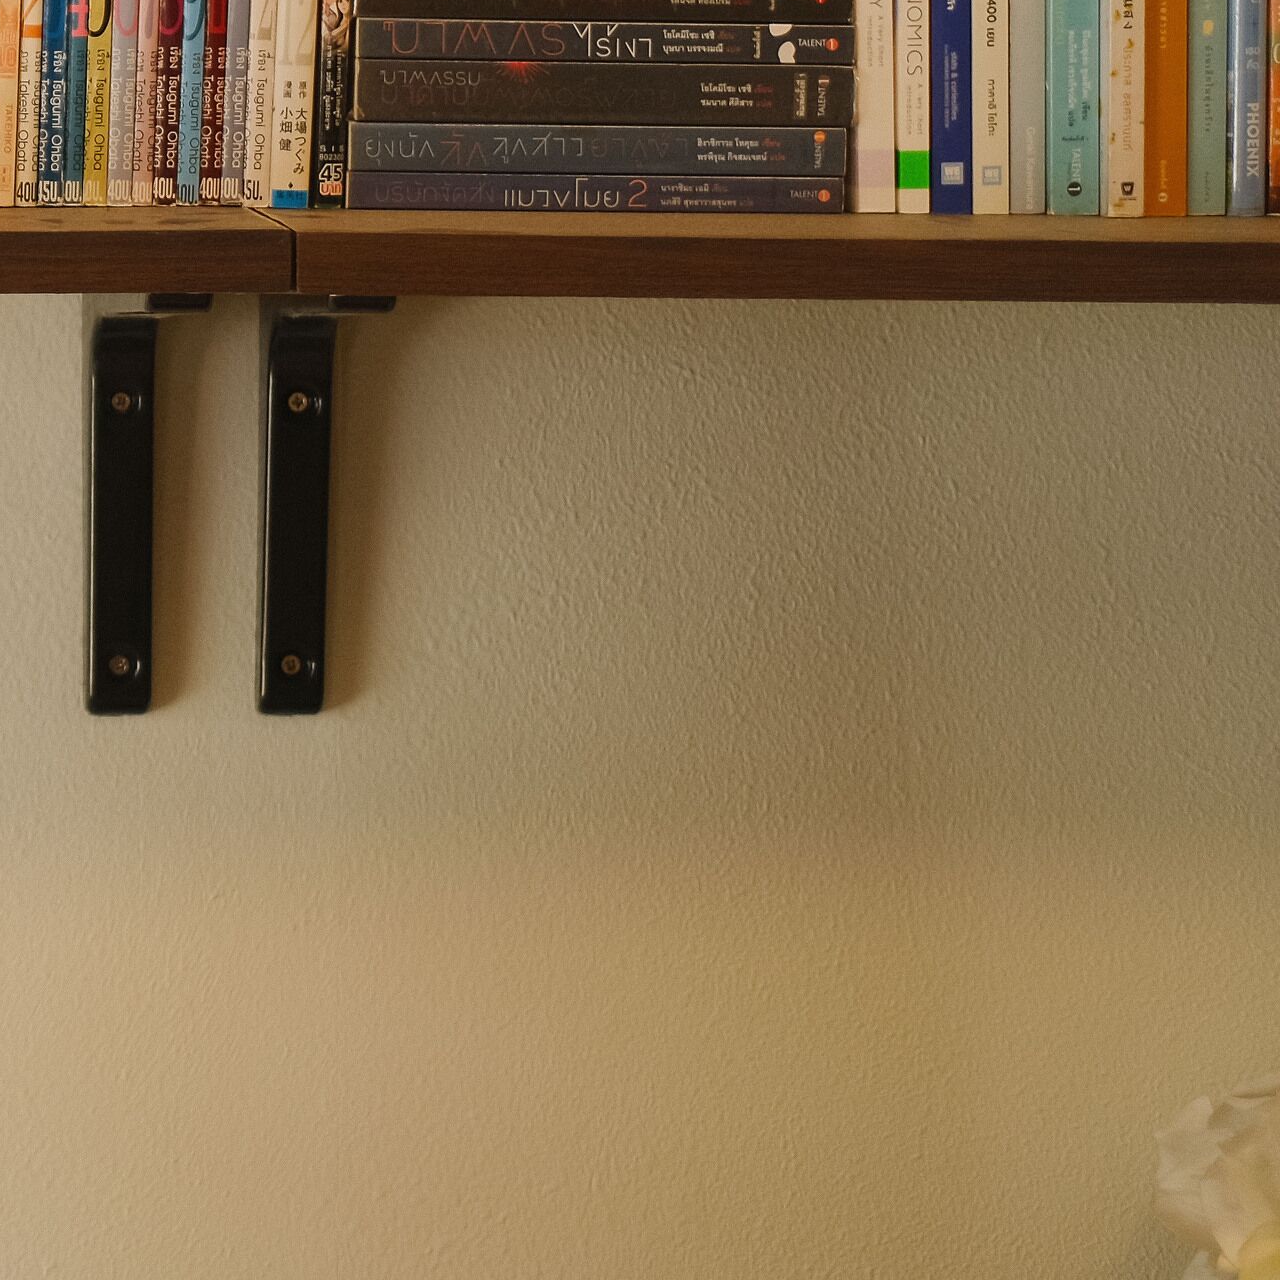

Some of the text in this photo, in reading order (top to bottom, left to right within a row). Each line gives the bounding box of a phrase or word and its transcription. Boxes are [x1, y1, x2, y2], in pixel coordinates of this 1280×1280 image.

[986, 0, 996, 23] 400
[798, 38, 826, 48] TALENT
[817, 88, 826, 117] TALENT
[50, 77, 65, 171] Tsugumi Ohba
[93, 77, 107, 171] Tsugumi Ohba
[166, 74, 180, 169] Tsugumi Ohba
[253, 77, 268, 170] Tsugumi Ohba
[293, 107, 308, 175] 大場つぐみ
[1246, 102, 1260, 177] PHOENIX
[319, 163, 343, 183] 45
[1071, 147, 1082, 180] TALENT
[628, 180, 648, 207] 2
[790, 190, 817, 198] TALENT
